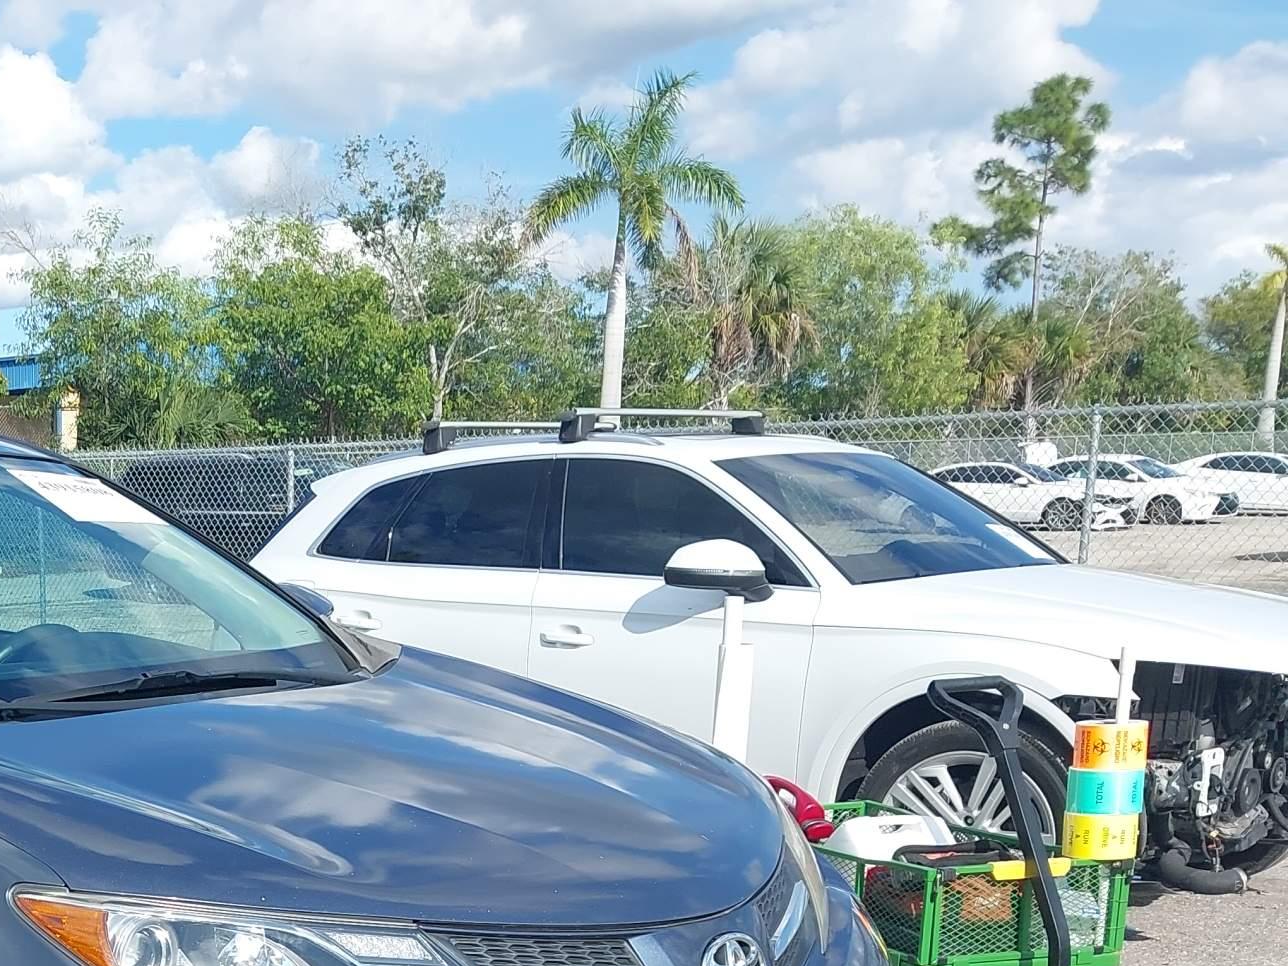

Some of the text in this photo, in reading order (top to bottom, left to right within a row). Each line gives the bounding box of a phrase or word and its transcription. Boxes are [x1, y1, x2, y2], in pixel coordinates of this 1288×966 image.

[1096, 781, 1105, 804] TOTAL
[1082, 829, 1090, 845] RUN
[1102, 827, 1110, 849] DRIVE
